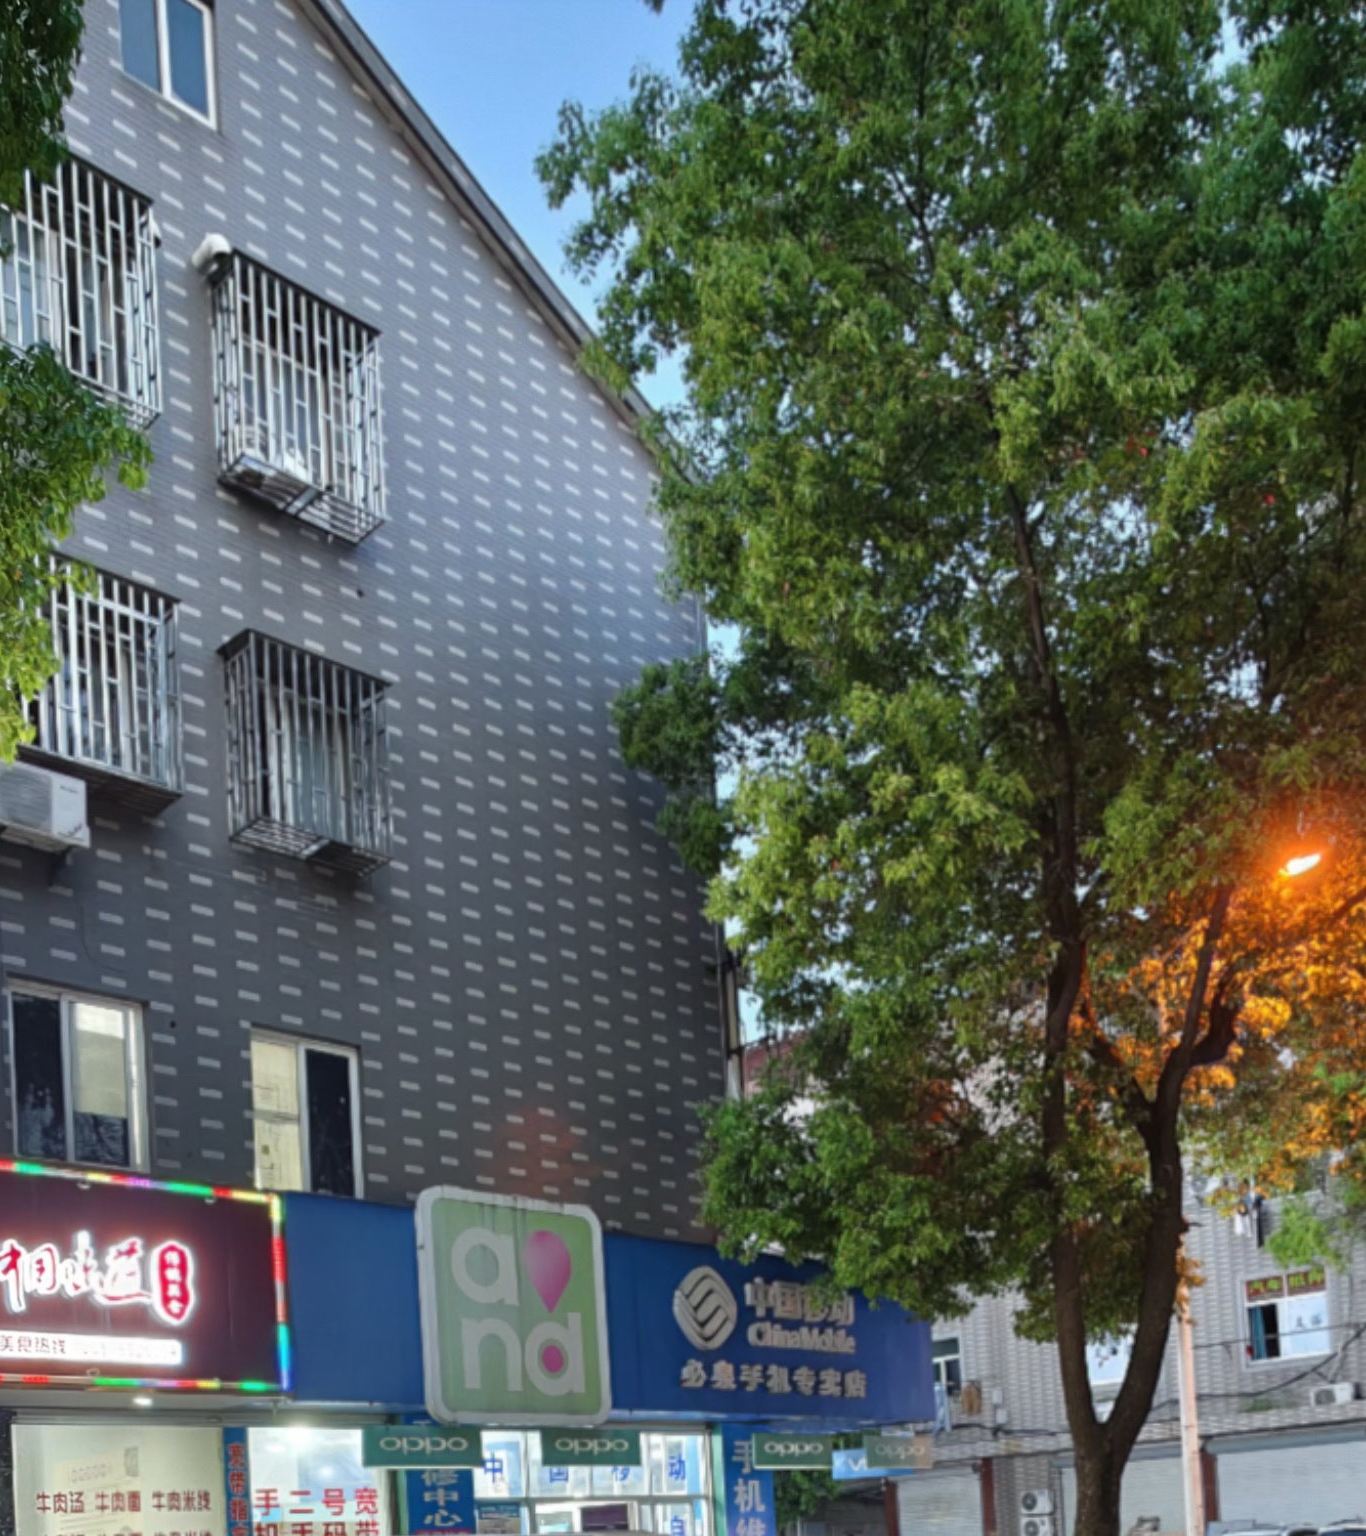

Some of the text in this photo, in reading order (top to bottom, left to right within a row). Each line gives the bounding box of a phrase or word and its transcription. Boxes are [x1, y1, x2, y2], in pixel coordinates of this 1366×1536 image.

[36, 1489, 212, 1514] 牛肉汤 牛肉面 牛肉米线
